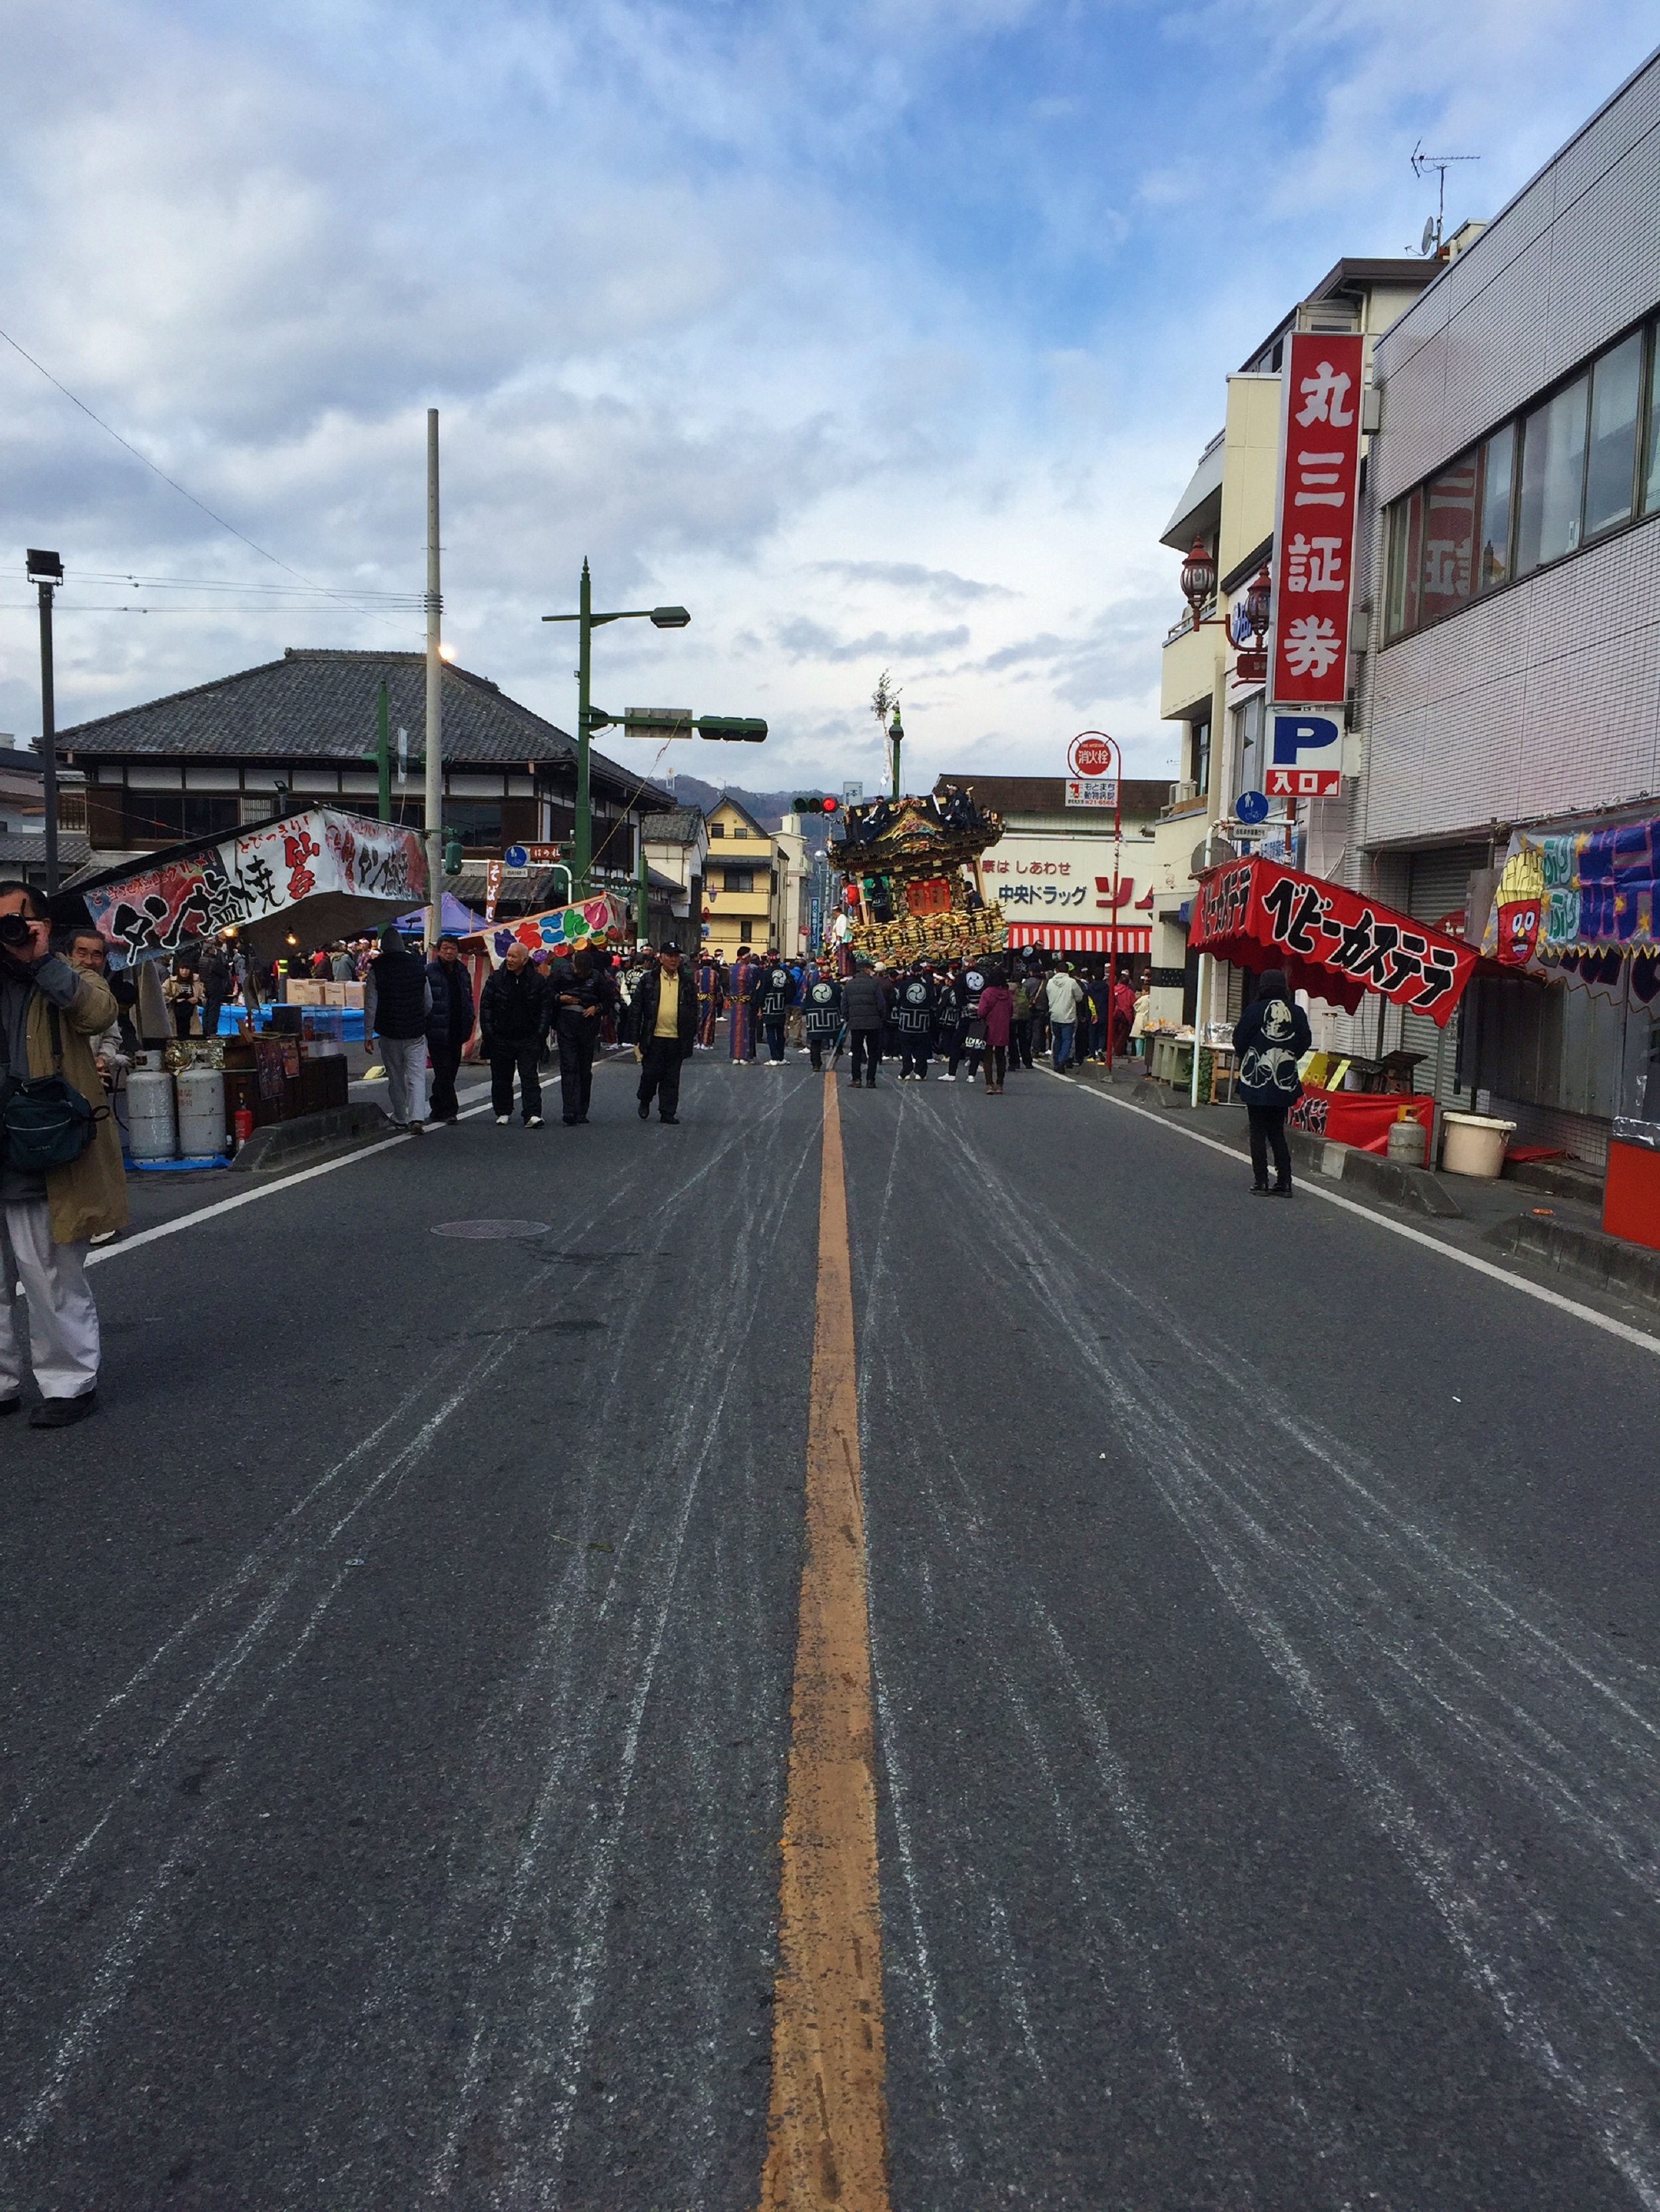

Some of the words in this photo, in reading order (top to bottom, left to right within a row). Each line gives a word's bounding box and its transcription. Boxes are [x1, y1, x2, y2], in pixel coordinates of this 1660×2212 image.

[1284, 360, 1355, 678] 丸三証券
[1078, 750, 1109, 764] 消火栓
[1272, 716, 1339, 764] P
[1273, 771, 1319, 794] 入口
[284, 831, 320, 900] 仙台
[1016, 860, 1071, 876] しあわせ
[999, 884, 1087, 906] 中央ドラッグ
[1201, 865, 1252, 939] ベビーカステラ
[1262, 876, 1458, 1008] ベビーカステラ
